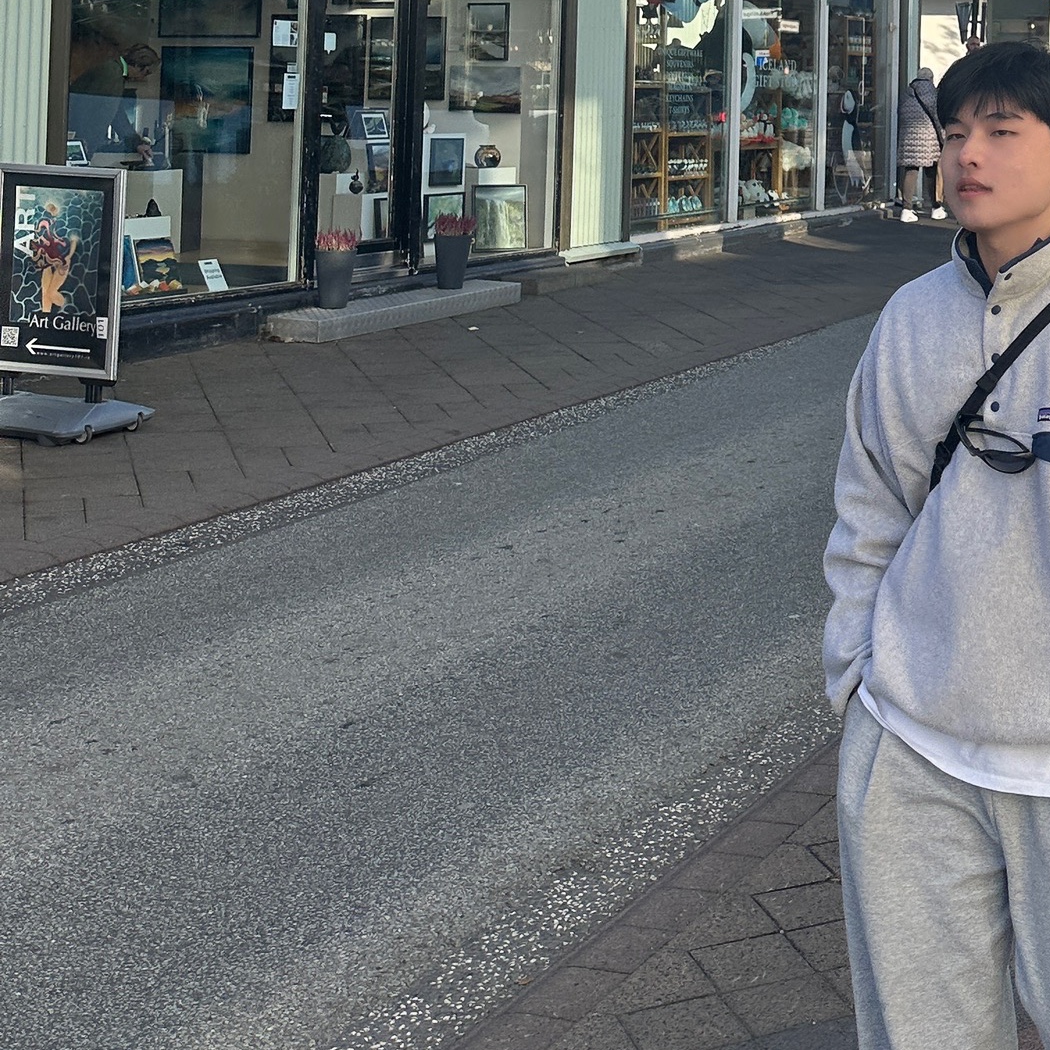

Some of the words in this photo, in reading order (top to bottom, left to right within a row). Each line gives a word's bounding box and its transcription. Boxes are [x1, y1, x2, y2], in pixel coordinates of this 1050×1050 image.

[759, 57, 797, 71] ICELAND
[14, 186, 36, 258] ART
[29, 314, 49, 329] Art
[53, 315, 96, 337] Gallery
